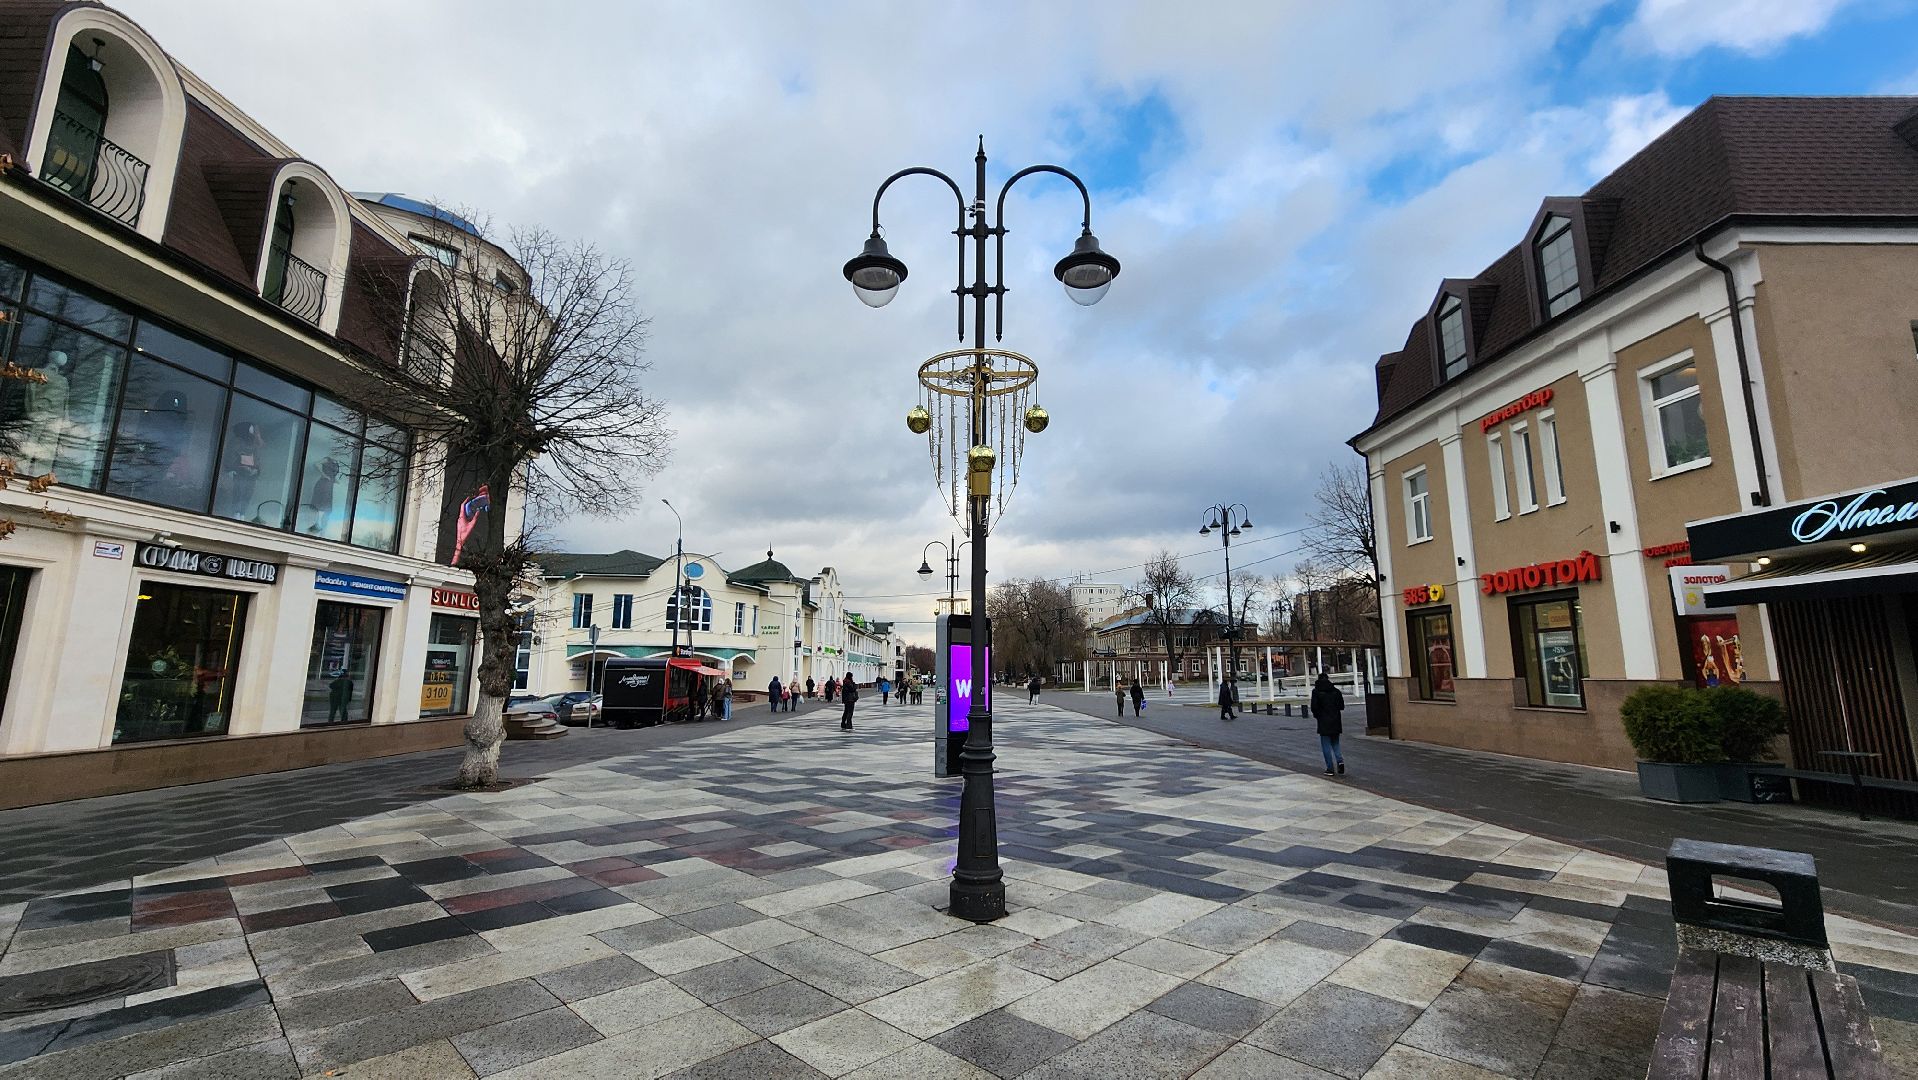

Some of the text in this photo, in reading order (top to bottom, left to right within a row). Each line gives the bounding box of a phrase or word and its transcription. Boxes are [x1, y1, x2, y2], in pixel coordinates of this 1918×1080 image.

[1642, 541, 1690, 558] ЮВЕЛИРН
[141, 545, 200, 572] СТУДИЯ
[226, 558, 277, 582] ЦВЕТОВ
[1403, 550, 1601, 606] 585 ЗОЛОТОЙ
[1683, 574, 1727, 585] ЗОЛОТОЙ
[432, 589, 480, 609] SUNLIG
[426, 686, 448, 699] 3100
[955, 679, 972, 698] W
